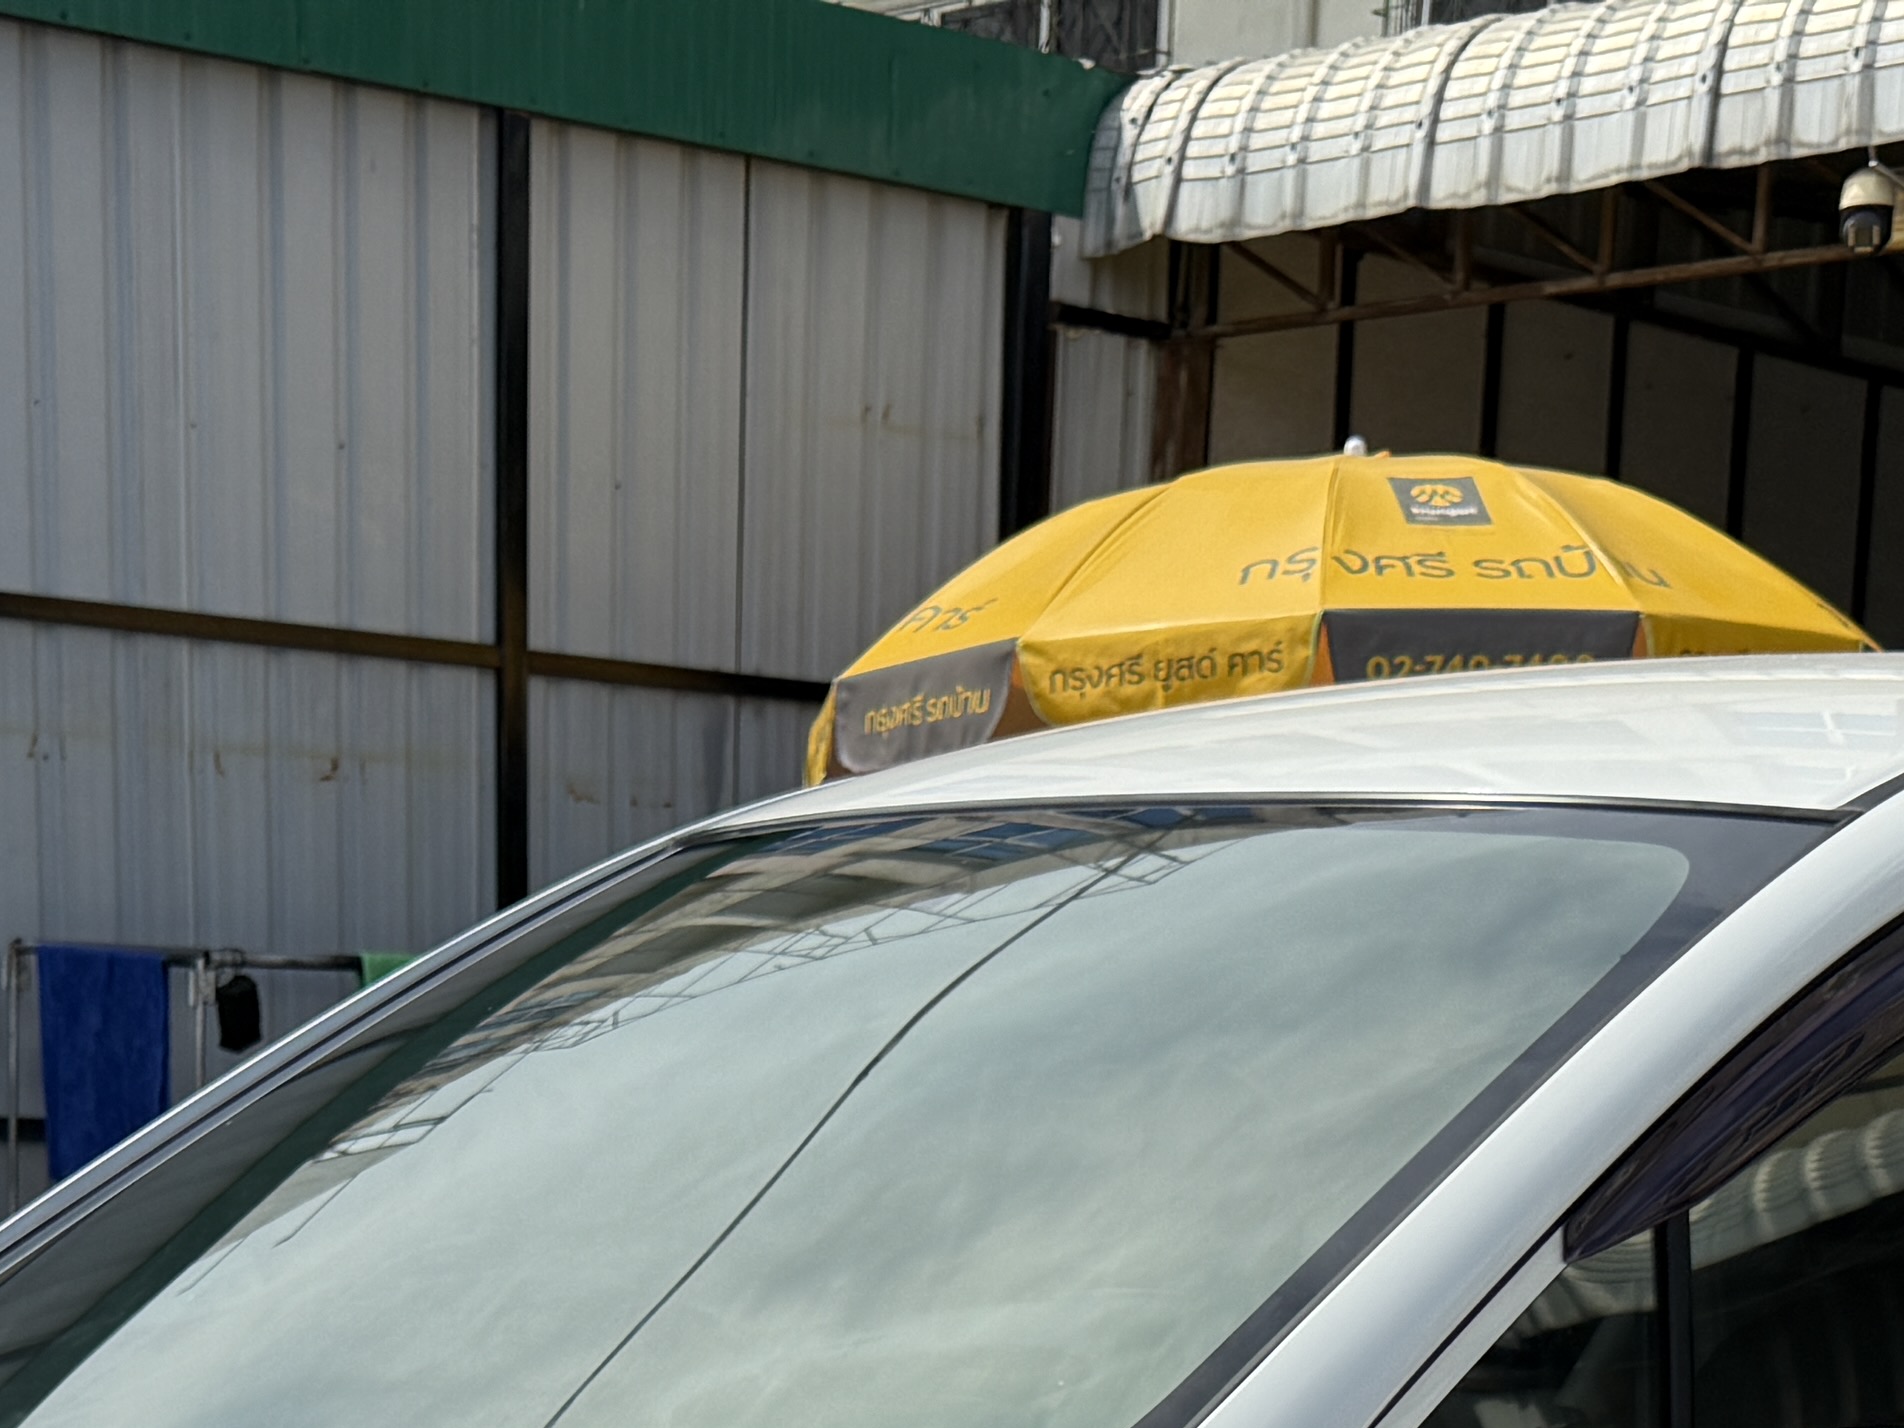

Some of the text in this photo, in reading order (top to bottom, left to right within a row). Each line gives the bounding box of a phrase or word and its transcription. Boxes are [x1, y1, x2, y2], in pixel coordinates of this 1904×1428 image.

[1238, 546, 1455, 586] กรุงศรี
[1049, 653, 1146, 700] กรุงศรี
[1227, 640, 1285, 678] คาร์
[864, 685, 991, 740] กรุงศรี รถบ้าน
